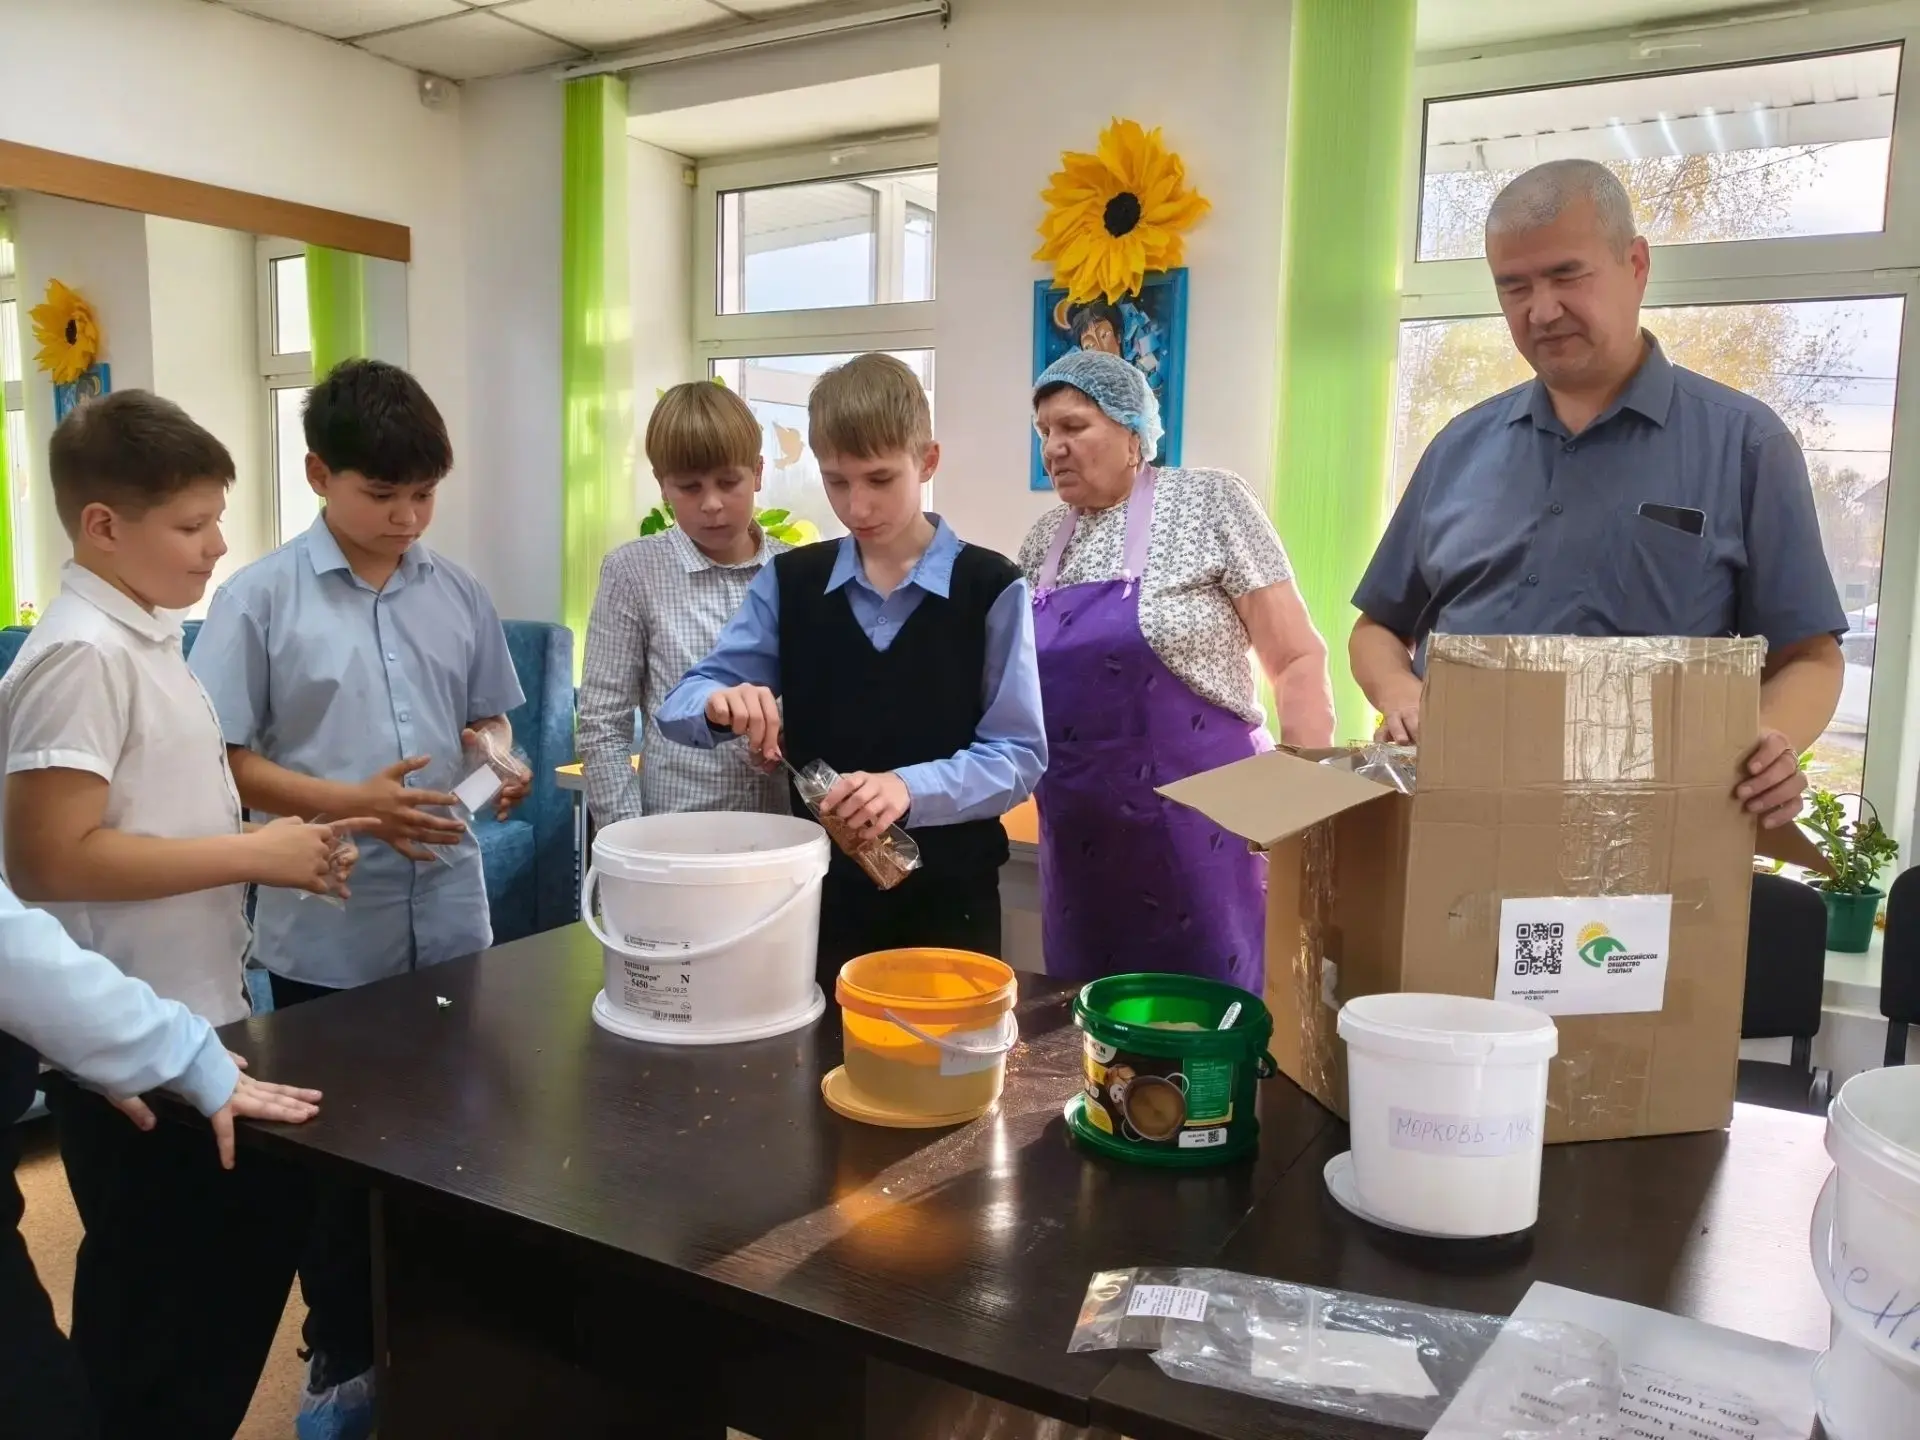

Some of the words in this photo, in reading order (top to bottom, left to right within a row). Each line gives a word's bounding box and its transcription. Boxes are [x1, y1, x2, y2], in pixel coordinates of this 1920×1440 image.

[1608, 952, 1658, 961] ВСЕРОССИЙСКОЕ
[631, 978, 649, 989] 5450
[1717, 1407, 1760, 1427] Соль
